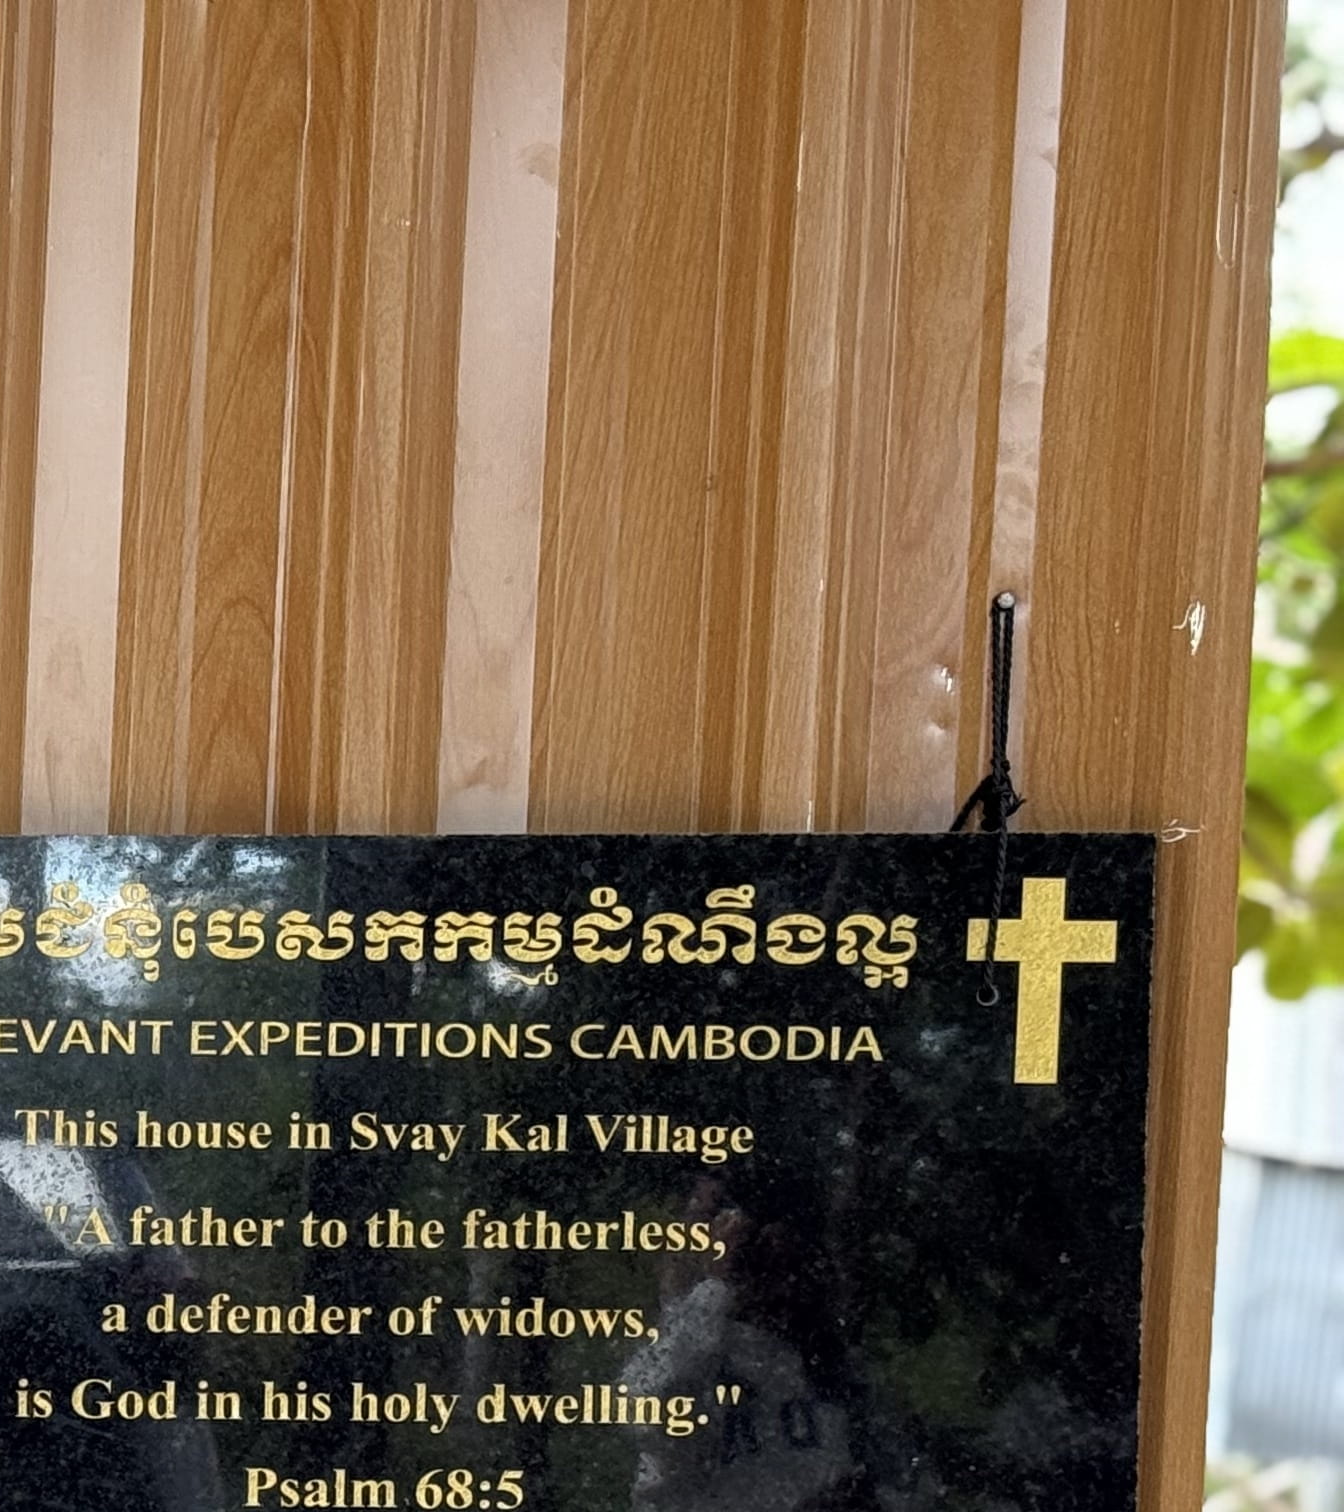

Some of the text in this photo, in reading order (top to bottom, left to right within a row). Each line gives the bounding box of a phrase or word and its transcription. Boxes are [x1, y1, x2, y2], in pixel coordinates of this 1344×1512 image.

[189, 1019, 554, 1060] EXPEDITIONS
[569, 1023, 883, 1062] CAMBODIA
[14, 1106, 754, 1165] This house in Svay Kal Village
[43, 1203, 727, 1258] "A father to the fatherless,
[101, 1292, 661, 1344] a defender of widows,
[15, 1377, 742, 1438] is God in his holy dwelling."
[245, 1466, 525, 1511] Psalm 68:5
